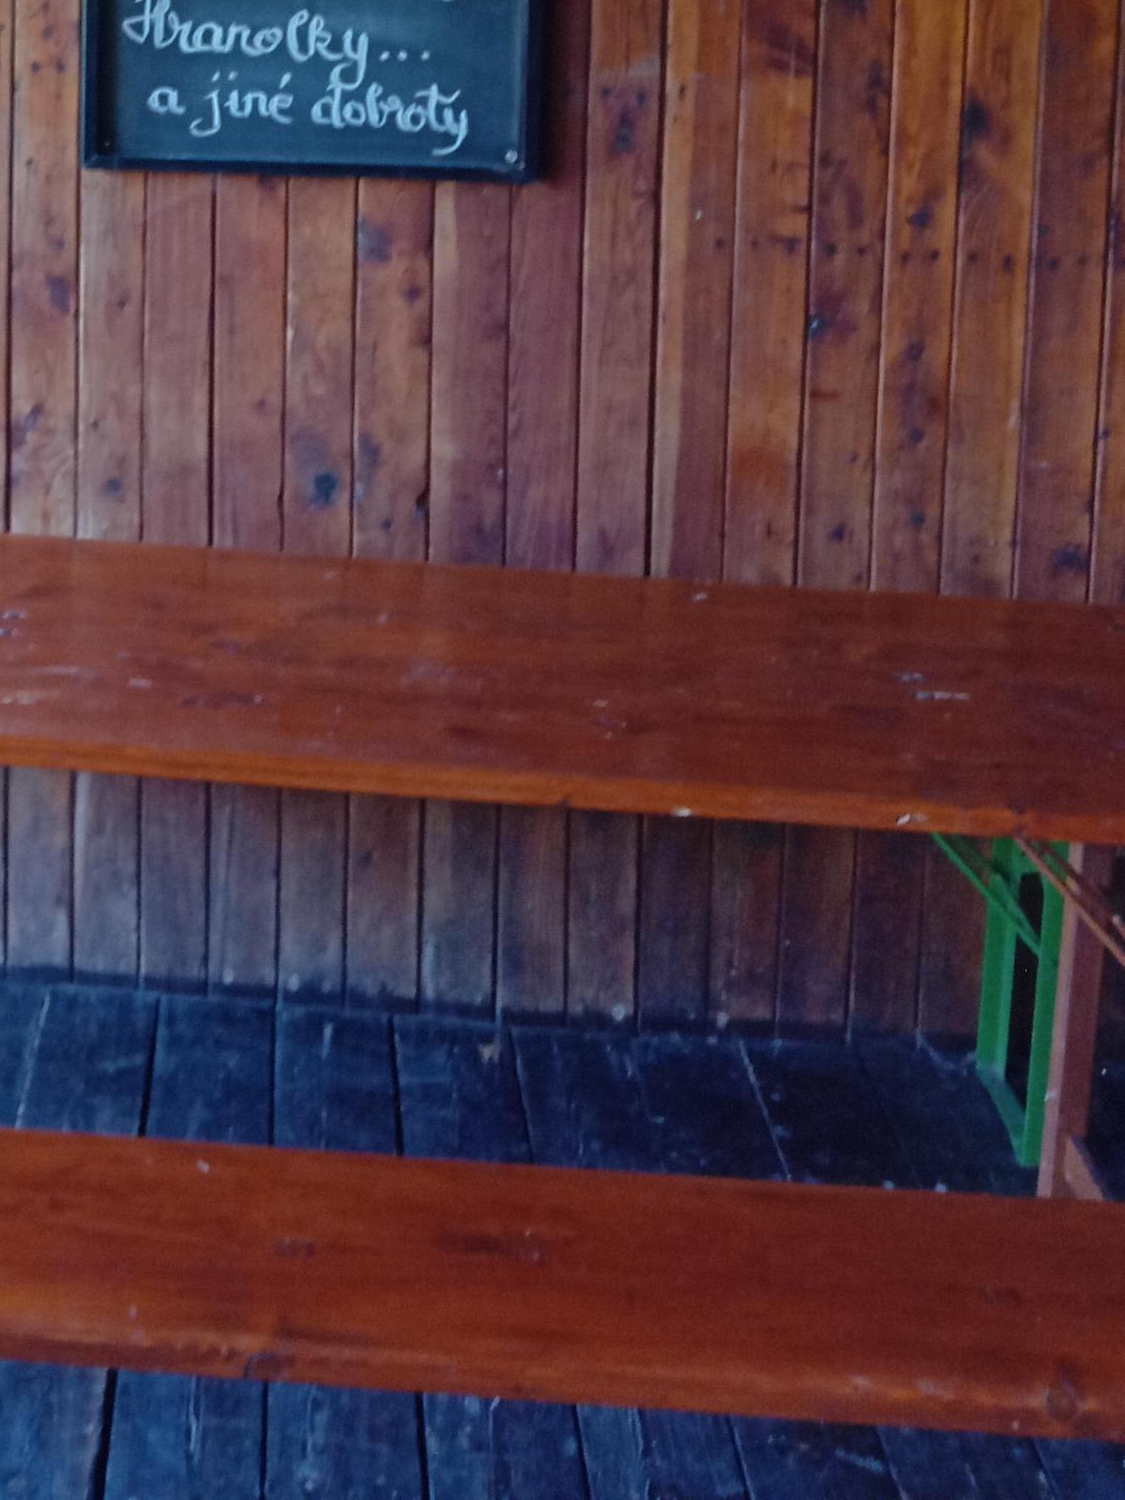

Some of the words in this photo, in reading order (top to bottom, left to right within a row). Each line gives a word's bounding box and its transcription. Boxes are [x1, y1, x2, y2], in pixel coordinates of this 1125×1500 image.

[147, 85, 186, 115] a
[188, 70, 295, 138] jiné
[310, 80, 469, 156] dobroty
